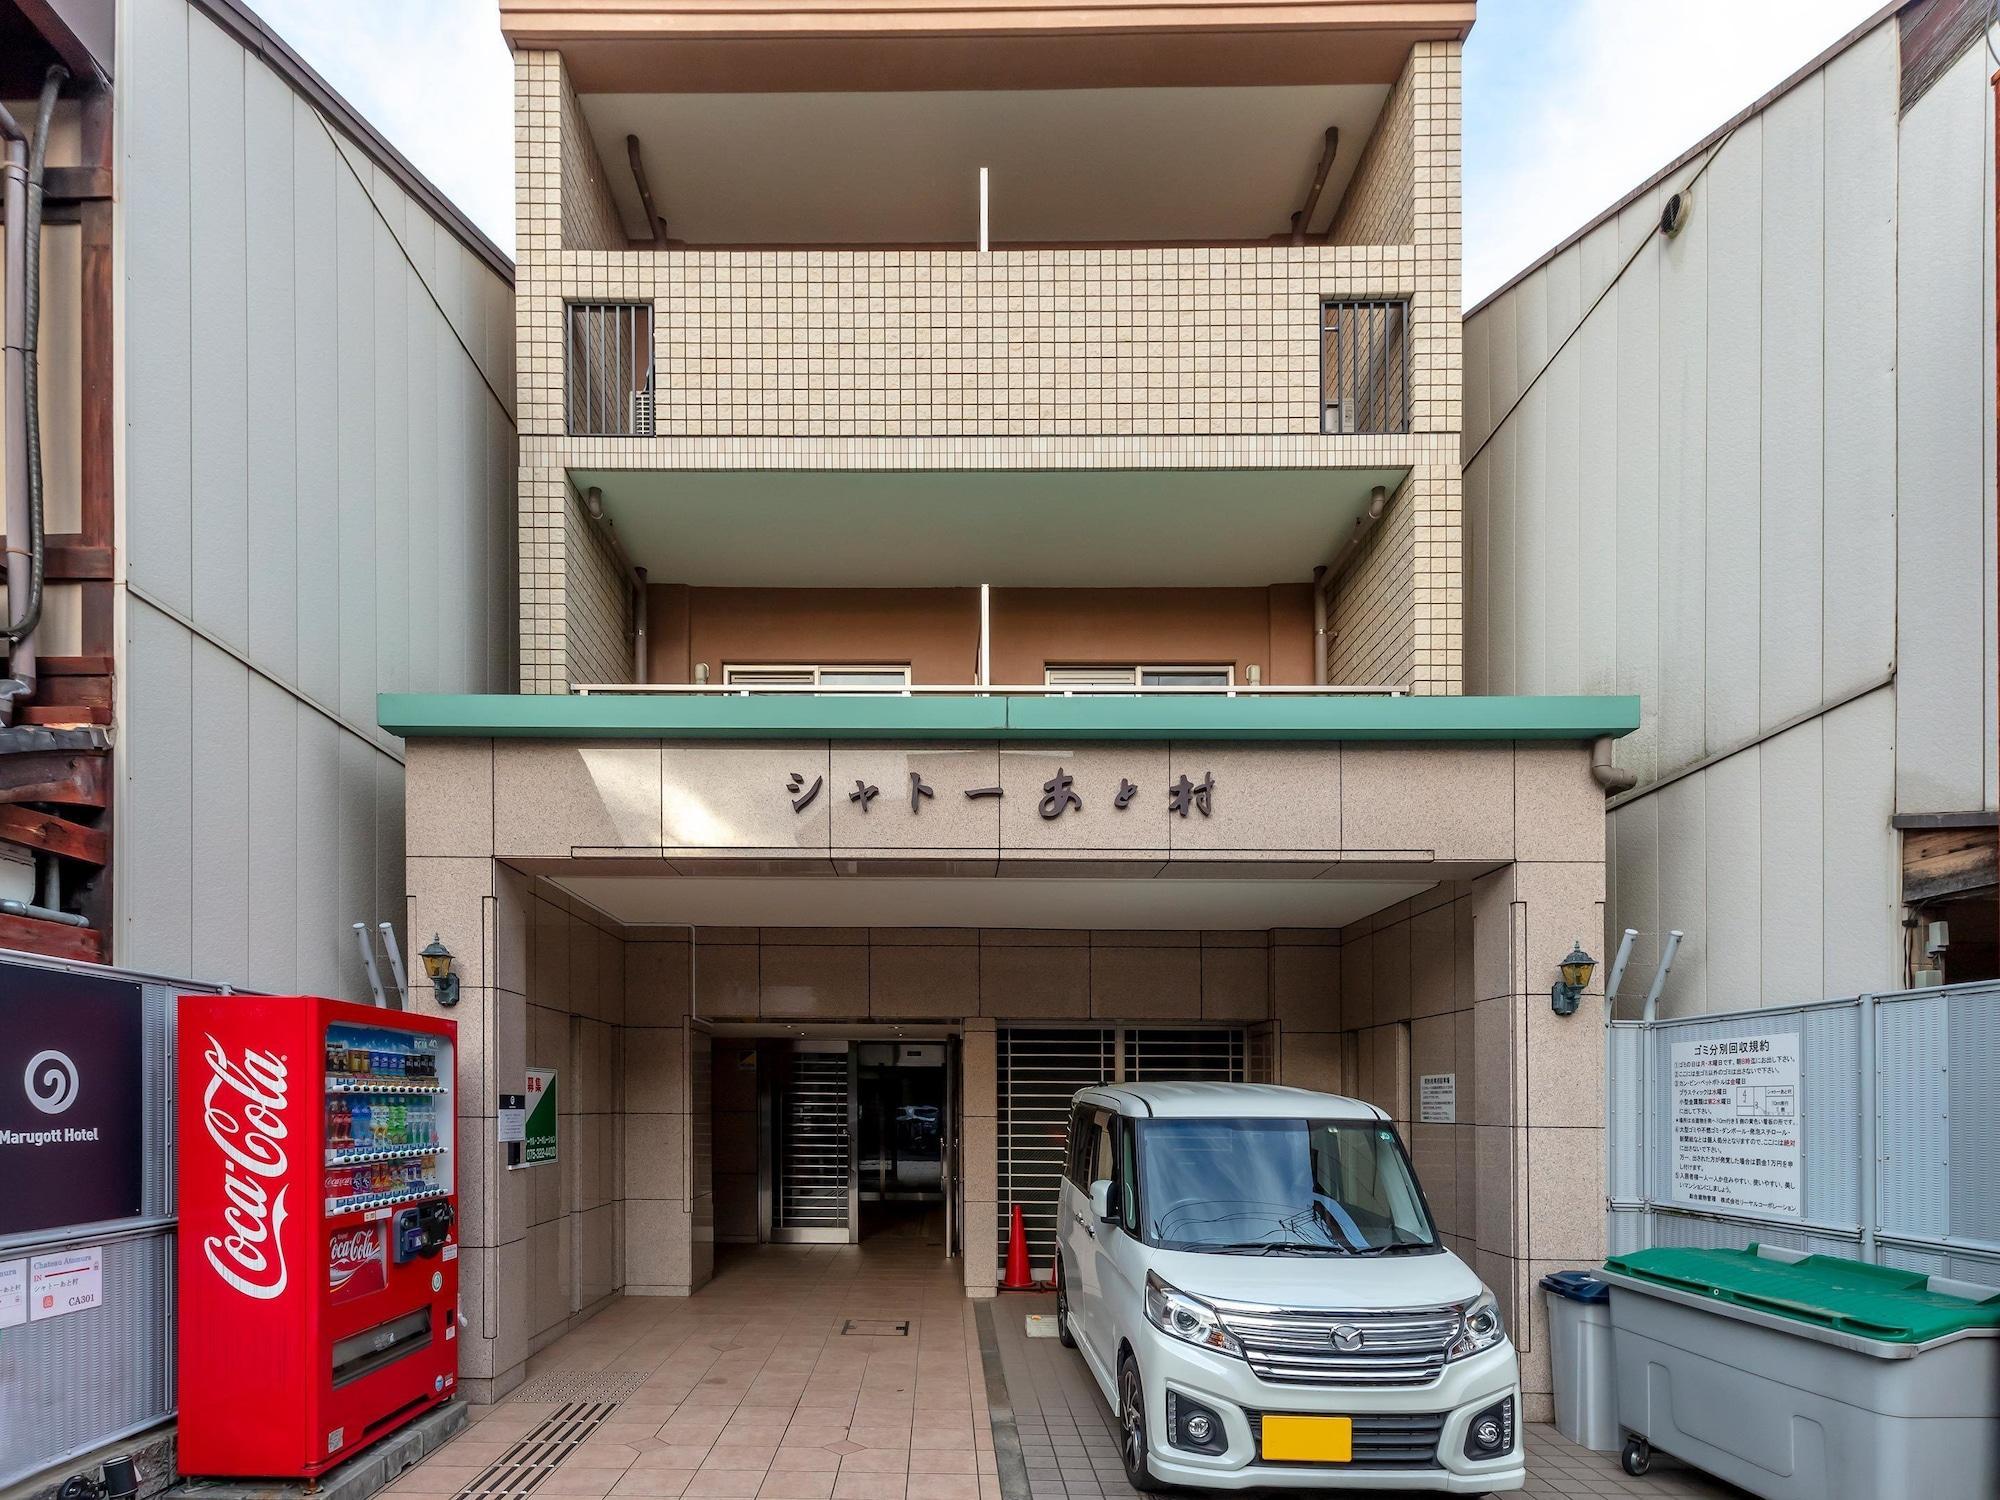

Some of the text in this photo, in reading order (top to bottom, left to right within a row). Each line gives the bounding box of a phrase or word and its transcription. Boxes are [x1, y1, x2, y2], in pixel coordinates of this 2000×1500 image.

[785, 767, 1216, 820] シャトーあと村
[1694, 1040, 1770, 1056] ゴミ分別回収規約
[0, 1127, 99, 1147] Marugott Hotel
[204, 1031, 289, 1300] Coca-Cola
[33, 1260, 63, 1271] Chateau
[33, 1274, 42, 1283] IN
[68, 1294, 95, 1307] CA301
